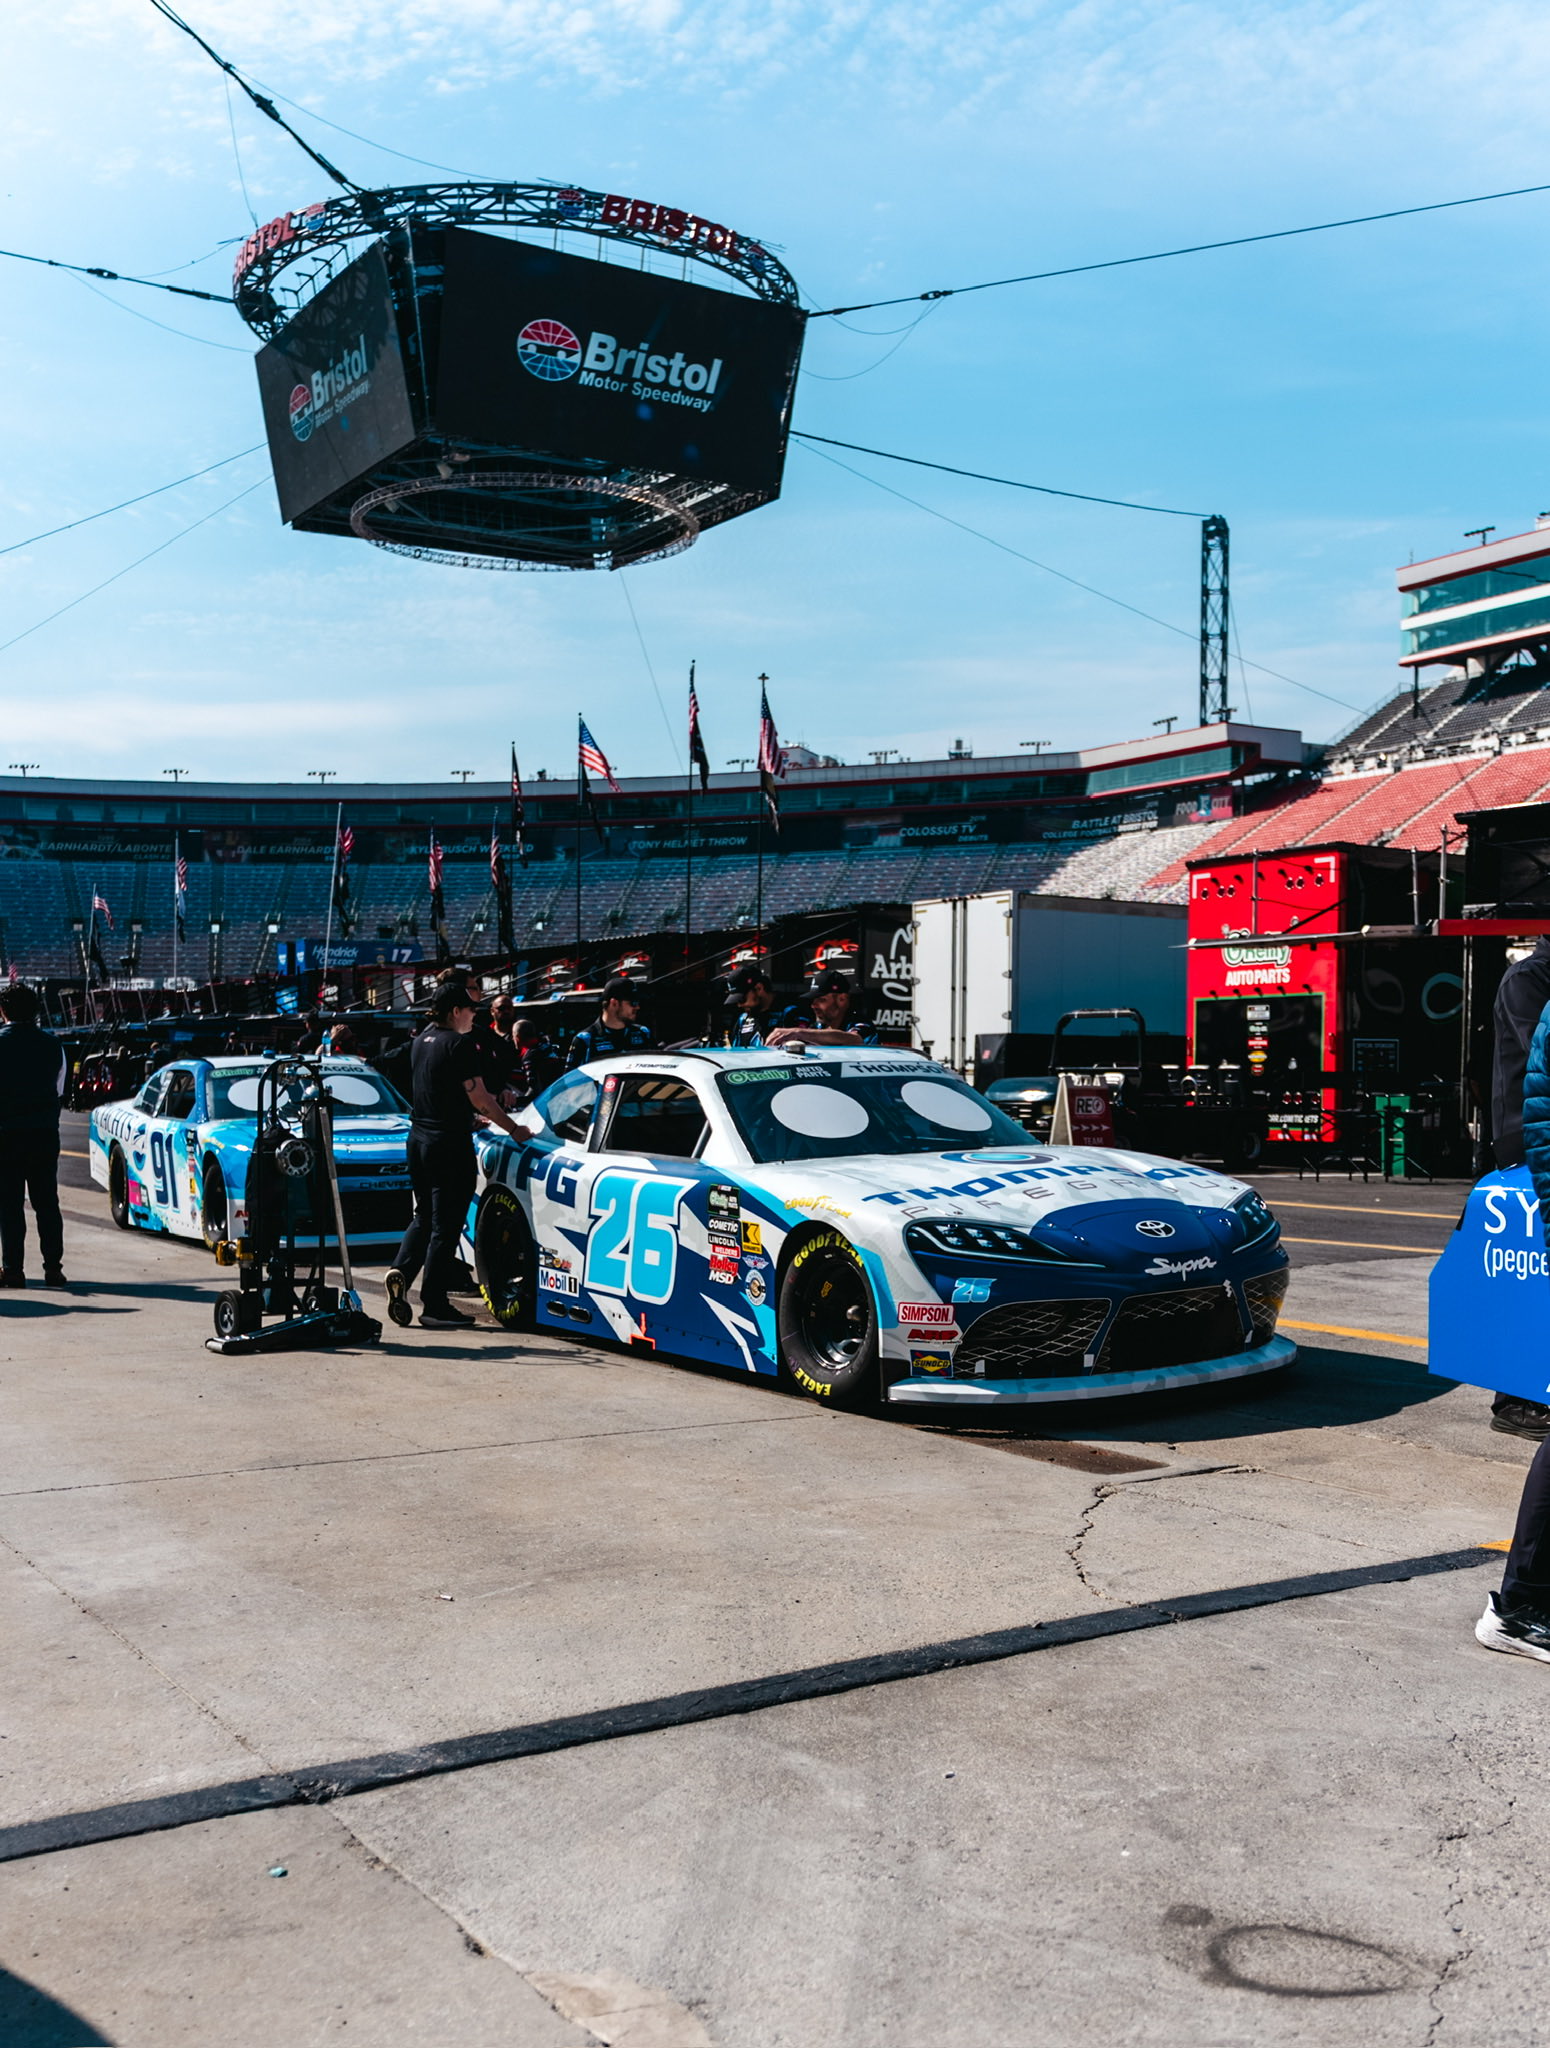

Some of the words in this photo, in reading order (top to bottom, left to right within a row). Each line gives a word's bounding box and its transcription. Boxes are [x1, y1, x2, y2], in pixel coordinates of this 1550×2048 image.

[601, 194, 743, 262] BRISTOL
[234, 211, 297, 286] RISTOL
[311, 333, 368, 411] Bristol
[583, 331, 723, 395] Bristol
[578, 370, 628, 393] Motor
[631, 381, 712, 413] Speedway
[1176, 800, 1198, 816] FOOD
[1211, 795, 1231, 809] CITY
[1071, 815, 1110, 830] BATTLE
[1111, 814, 1121, 825] AT
[1122, 809, 1159, 824] BRISTOL
[899, 824, 959, 837] COLOSSUS
[961, 824, 977, 833] TV
[1042, 830, 1078, 840] COLLEGE
[40, 841, 172, 854] EARNHARDT/LABONTE
[236, 845, 266, 855] DALE
[269, 845, 337, 855] EARNHARDT
[441, 844, 477, 854] BUSCH
[480, 843, 534, 854] WEKED
[631, 840, 661, 850] TONY
[708, 836, 748, 847] THROW
[318, 957, 355, 966] Crs.com
[391, 949, 413, 963] 17
[1225, 970, 1254, 986] AUTO
[1254, 968, 1291, 985] PARTS
[319, 1064, 364, 1074] AGGIO
[726, 1068, 791, 1086] O'Reilly
[796, 1065, 823, 1073] AUTO
[796, 1071, 832, 1079] PARTS
[150, 1131, 180, 1211] 91
[495, 1142, 586, 1209] TPG
[861, 1165, 1224, 1206] THOMPSON
[494, 1193, 518, 1213] EAGLE
[783, 1194, 853, 1219] GOODYEAR
[708, 1219, 739, 1232] COMETIC
[583, 1170, 698, 1304] 26
[708, 1235, 736, 1248] LINCOLN
[714, 1246, 738, 1257] WELDERS
[793, 1231, 865, 1269] GOODYEAR
[709, 1254, 739, 1277] Holley
[1144, 1256, 1217, 1282] Supra
[540, 1269, 567, 1292] Mobil
[569, 1277, 577, 1294] 1
[708, 1270, 735, 1285] MSD
[951, 1277, 998, 1303] 26
[901, 1305, 951, 1322] SIMPSON
[907, 1328, 959, 1341] ARP
[914, 1359, 950, 1368] SUNOCO
[793, 1367, 832, 1397] EAGLE
